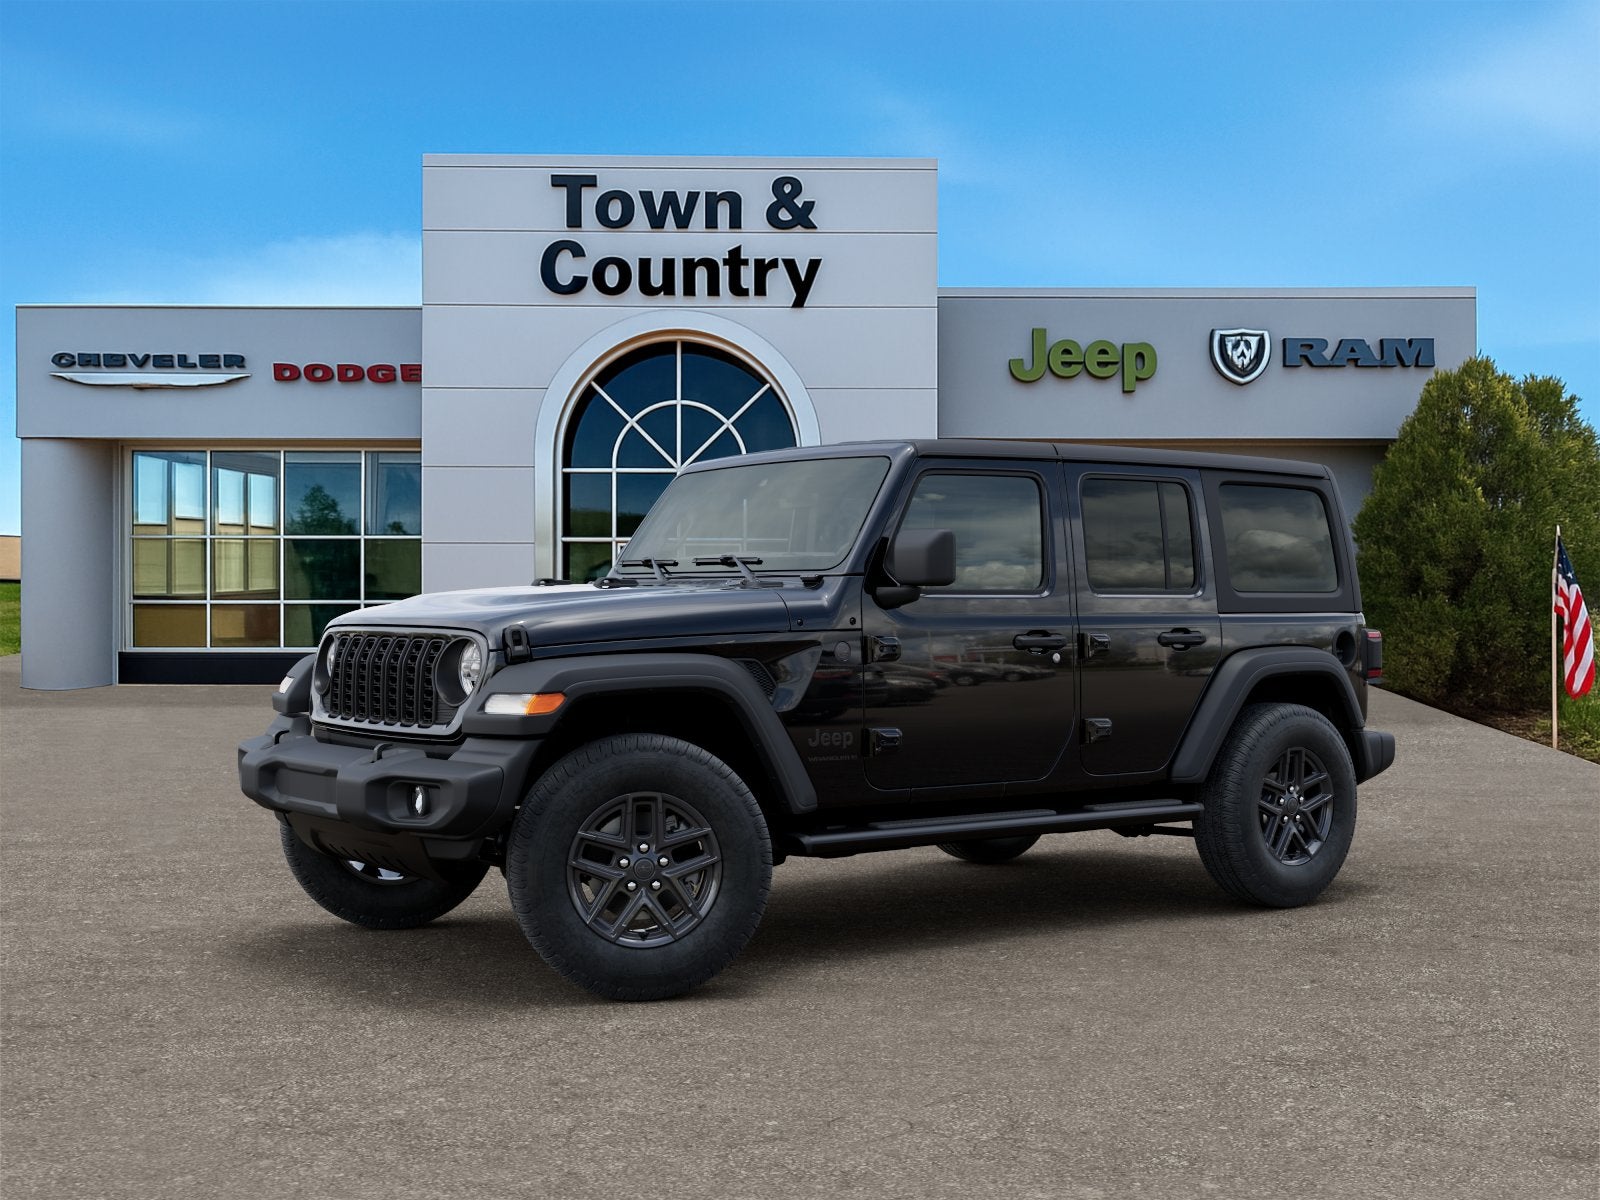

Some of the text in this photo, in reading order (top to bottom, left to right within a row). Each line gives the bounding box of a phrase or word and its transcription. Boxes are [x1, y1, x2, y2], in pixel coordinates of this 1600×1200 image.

[550, 174, 818, 230] Town &
[540, 239, 822, 308] Country
[273, 362, 422, 383] DODGE
[1009, 328, 1158, 393] Jeep
[1282, 337, 1436, 368] RAM
[807, 728, 854, 749] Jeep
